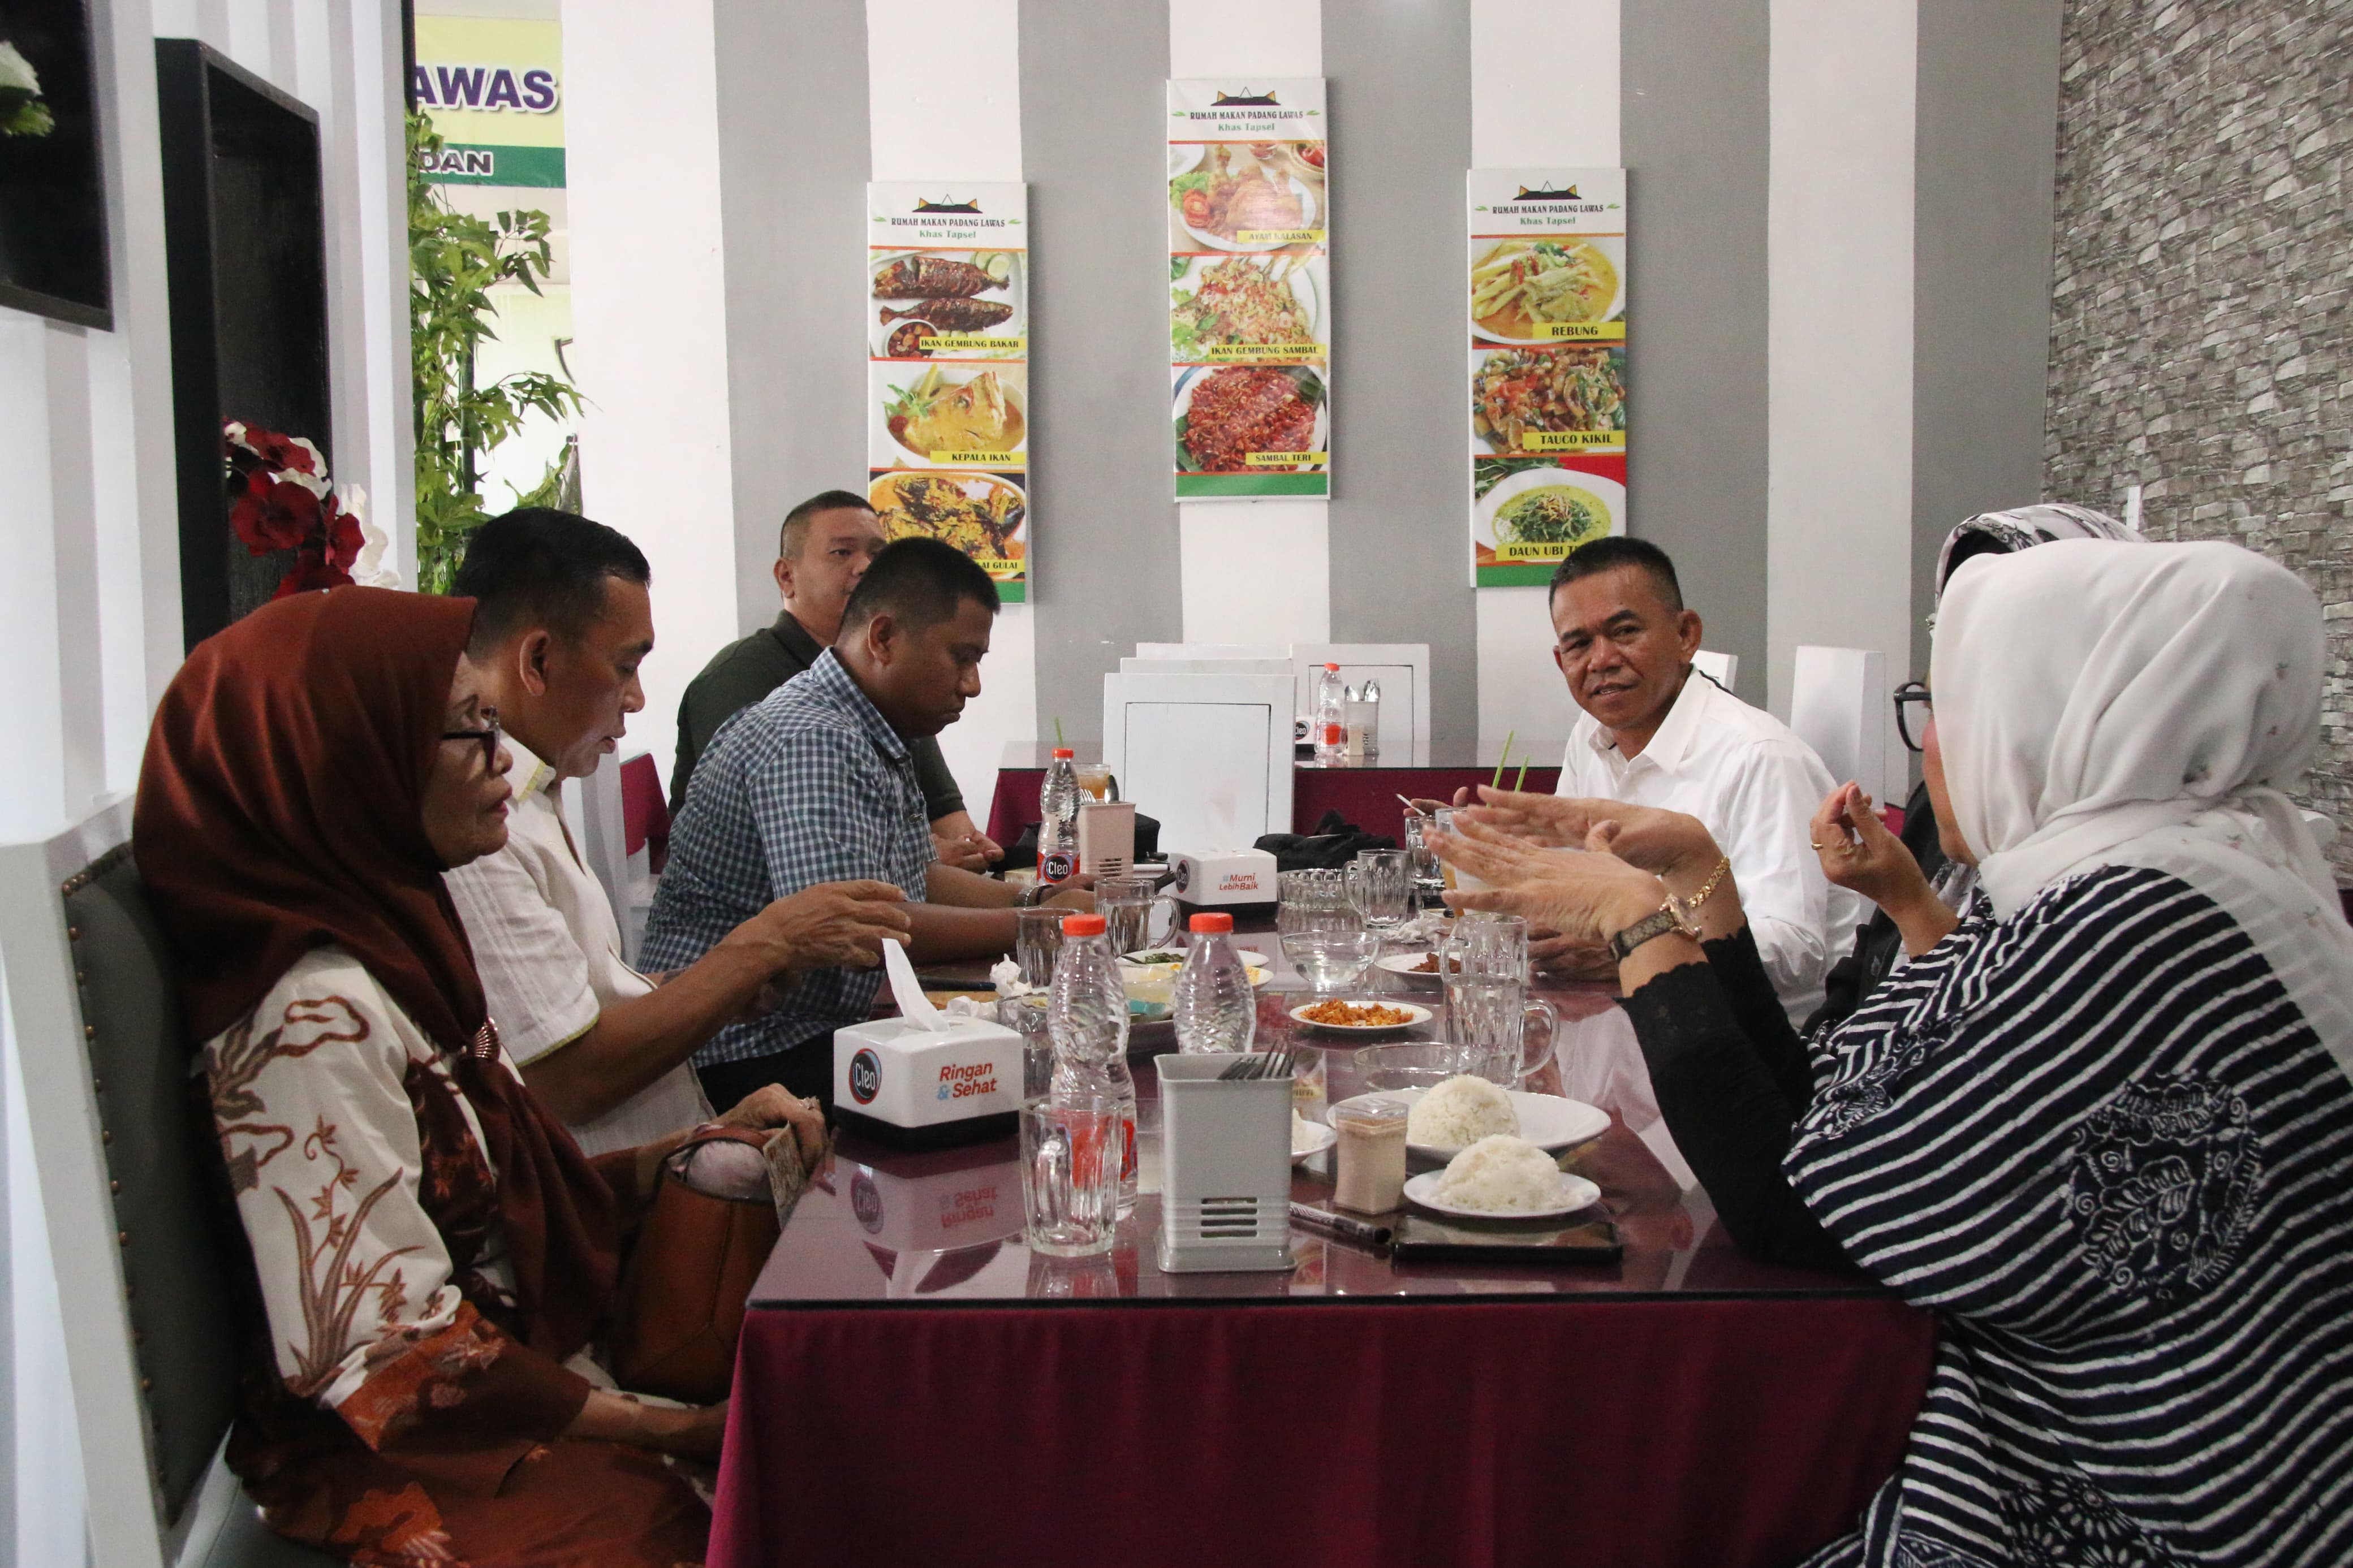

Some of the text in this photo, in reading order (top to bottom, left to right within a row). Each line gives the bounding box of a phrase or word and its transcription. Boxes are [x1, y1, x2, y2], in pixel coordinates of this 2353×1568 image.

[1248, 111, 1277, 119] PADANG
[1246, 123, 1274, 132] Tapsel
[1549, 205, 1578, 213] PADANG
[1546, 217, 1575, 226] Tapsel
[947, 230, 976, 239] Tapsel
[1552, 326, 1598, 335] REBUNG
[1540, 434, 1613, 444] TAUCO KIKIL
[1509, 547, 1540, 556] DAUN
[1544, 546, 1563, 555] UBI
[1048, 862, 1068, 875] Cleo
[856, 1063, 876, 1090] Cleo
[940, 1062, 993, 1082] Ringan
[937, 1078, 997, 1100] & Sehat
